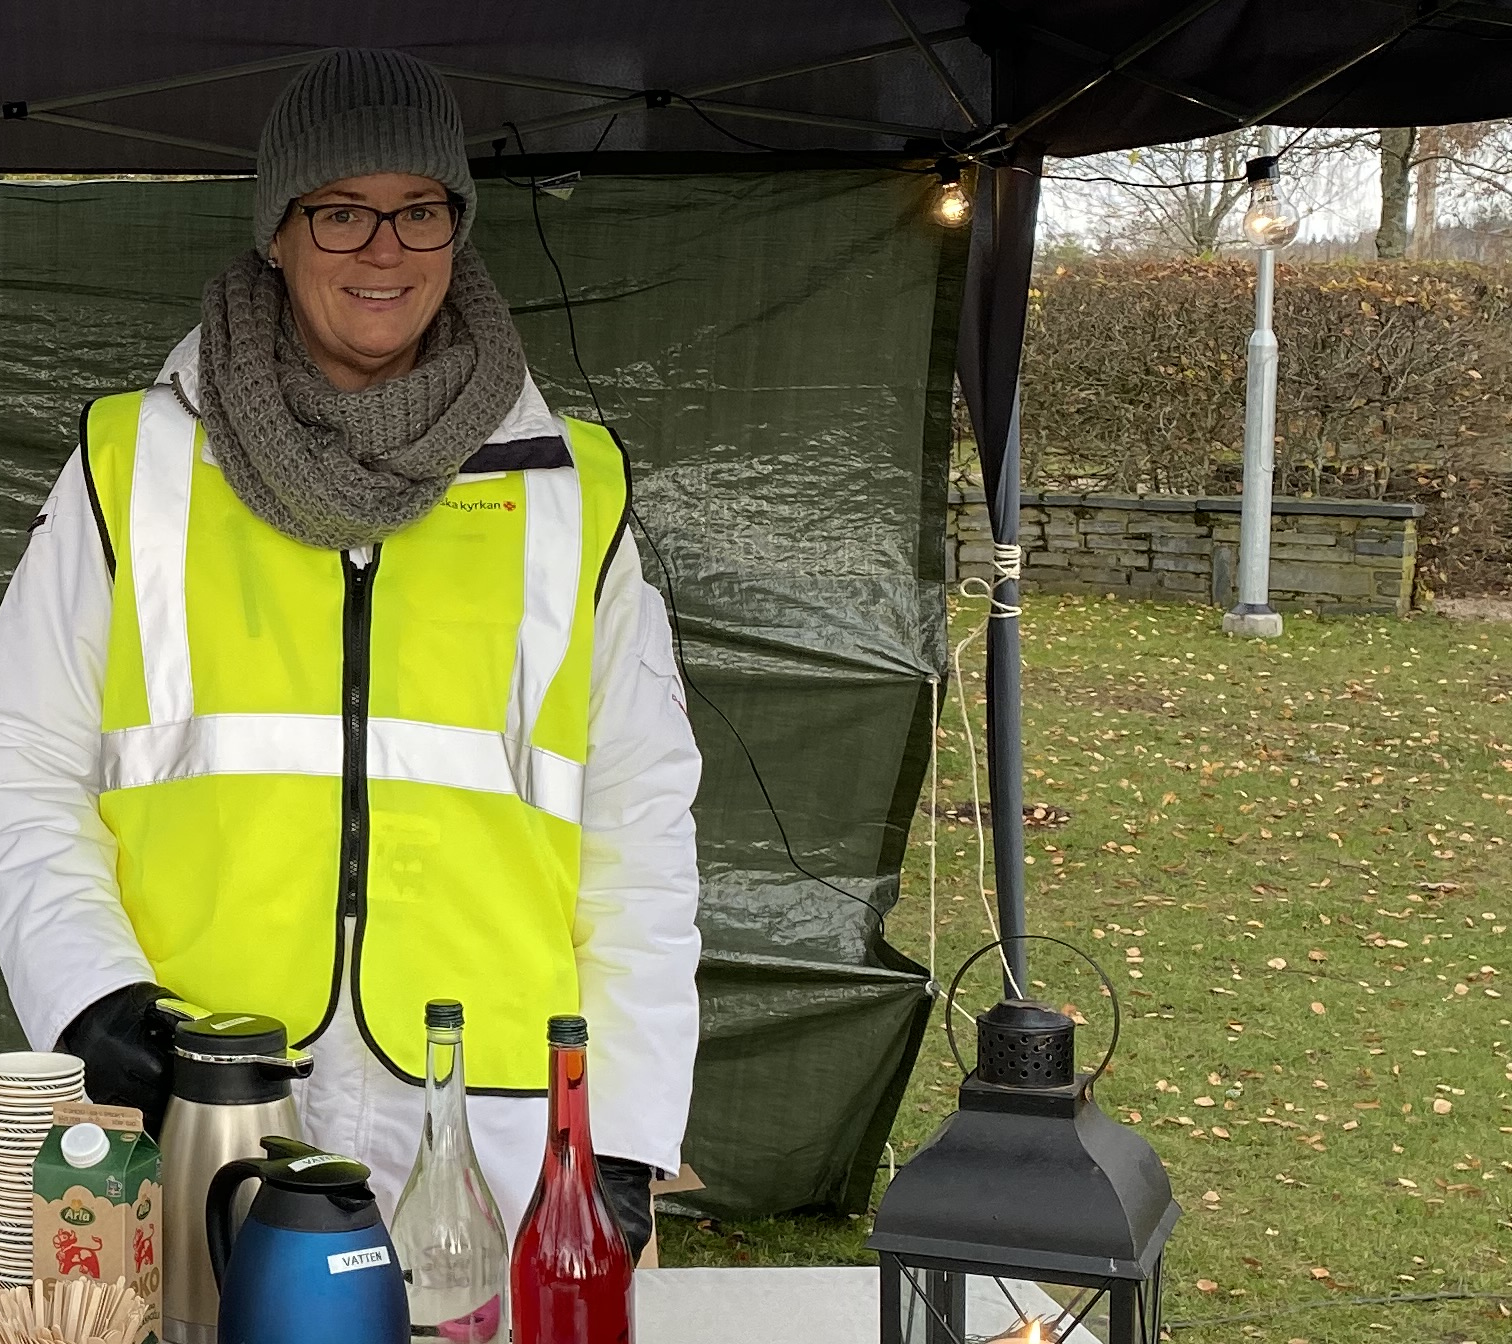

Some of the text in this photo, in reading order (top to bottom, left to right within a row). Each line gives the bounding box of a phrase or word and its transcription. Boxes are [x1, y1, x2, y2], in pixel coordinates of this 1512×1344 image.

[460, 500, 501, 512] kyrkan
[64, 1209, 90, 1222] Arla
[342, 1251, 383, 1267] VATTEN
